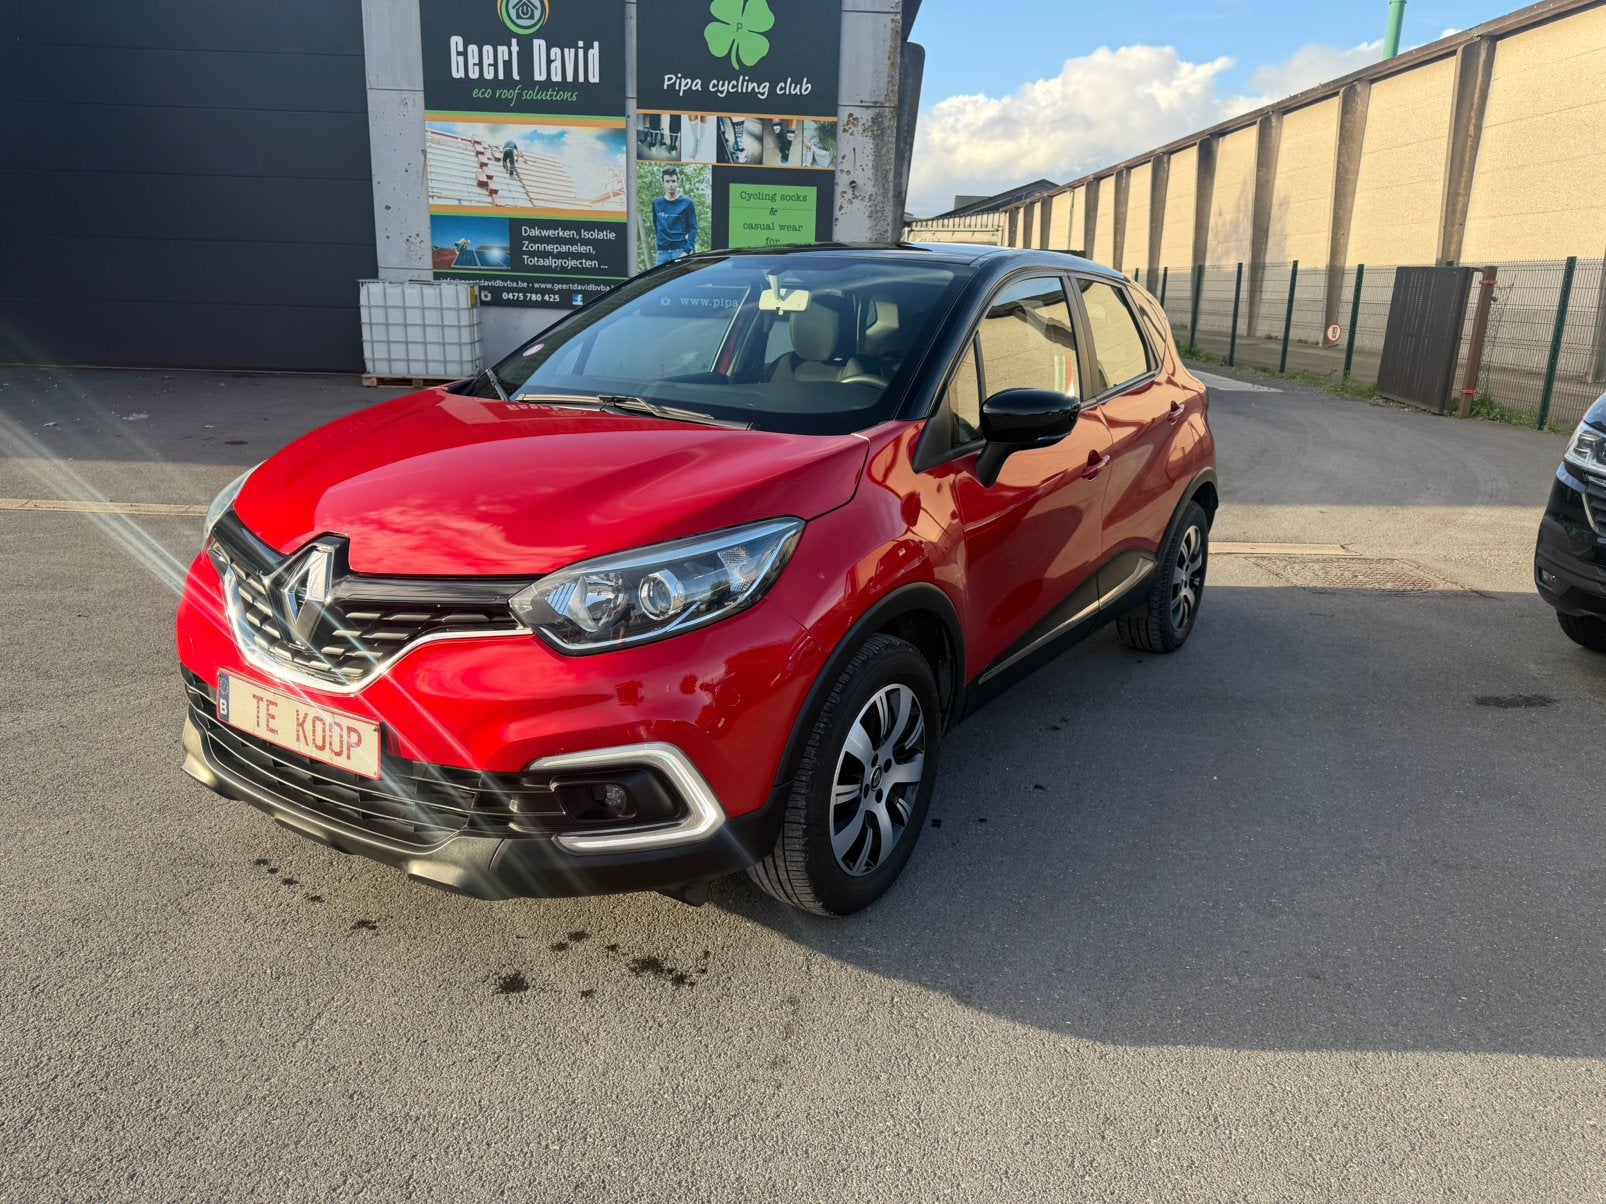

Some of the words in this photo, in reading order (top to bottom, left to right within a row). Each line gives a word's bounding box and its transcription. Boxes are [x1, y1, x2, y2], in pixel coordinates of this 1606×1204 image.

[450, 35, 520, 80] Geert
[532, 38, 600, 84] David
[663, 73, 702, 96] Pipa
[709, 75, 770, 99] cycling
[776, 77, 812, 95] club
[472, 87, 492, 98] eco
[495, 84, 522, 107] roof
[522, 85, 578, 101] solutions
[740, 190, 777, 203] Cycling
[780, 192, 808, 202] socks
[769, 207, 778, 216] &
[521, 226, 579, 240] Dakwerken,
[581, 228, 616, 240] Isolatie
[742, 222, 775, 231] casual
[778, 224, 804, 232] wear
[522, 241, 596, 255] Zonnepanelen,
[765, 237, 781, 246] for
[522, 255, 599, 269] Totaalprojecten
[440, 277, 528, 288] davidbvba.be
[533, 282, 614, 292] www.geertdavidbvba
[502, 292, 524, 301] 0475
[525, 293, 542, 301] 780
[543, 294, 560, 302] 425
[219, 698, 228, 715] B
[252, 694, 279, 735] TE
[296, 709, 362, 760] KOOP
